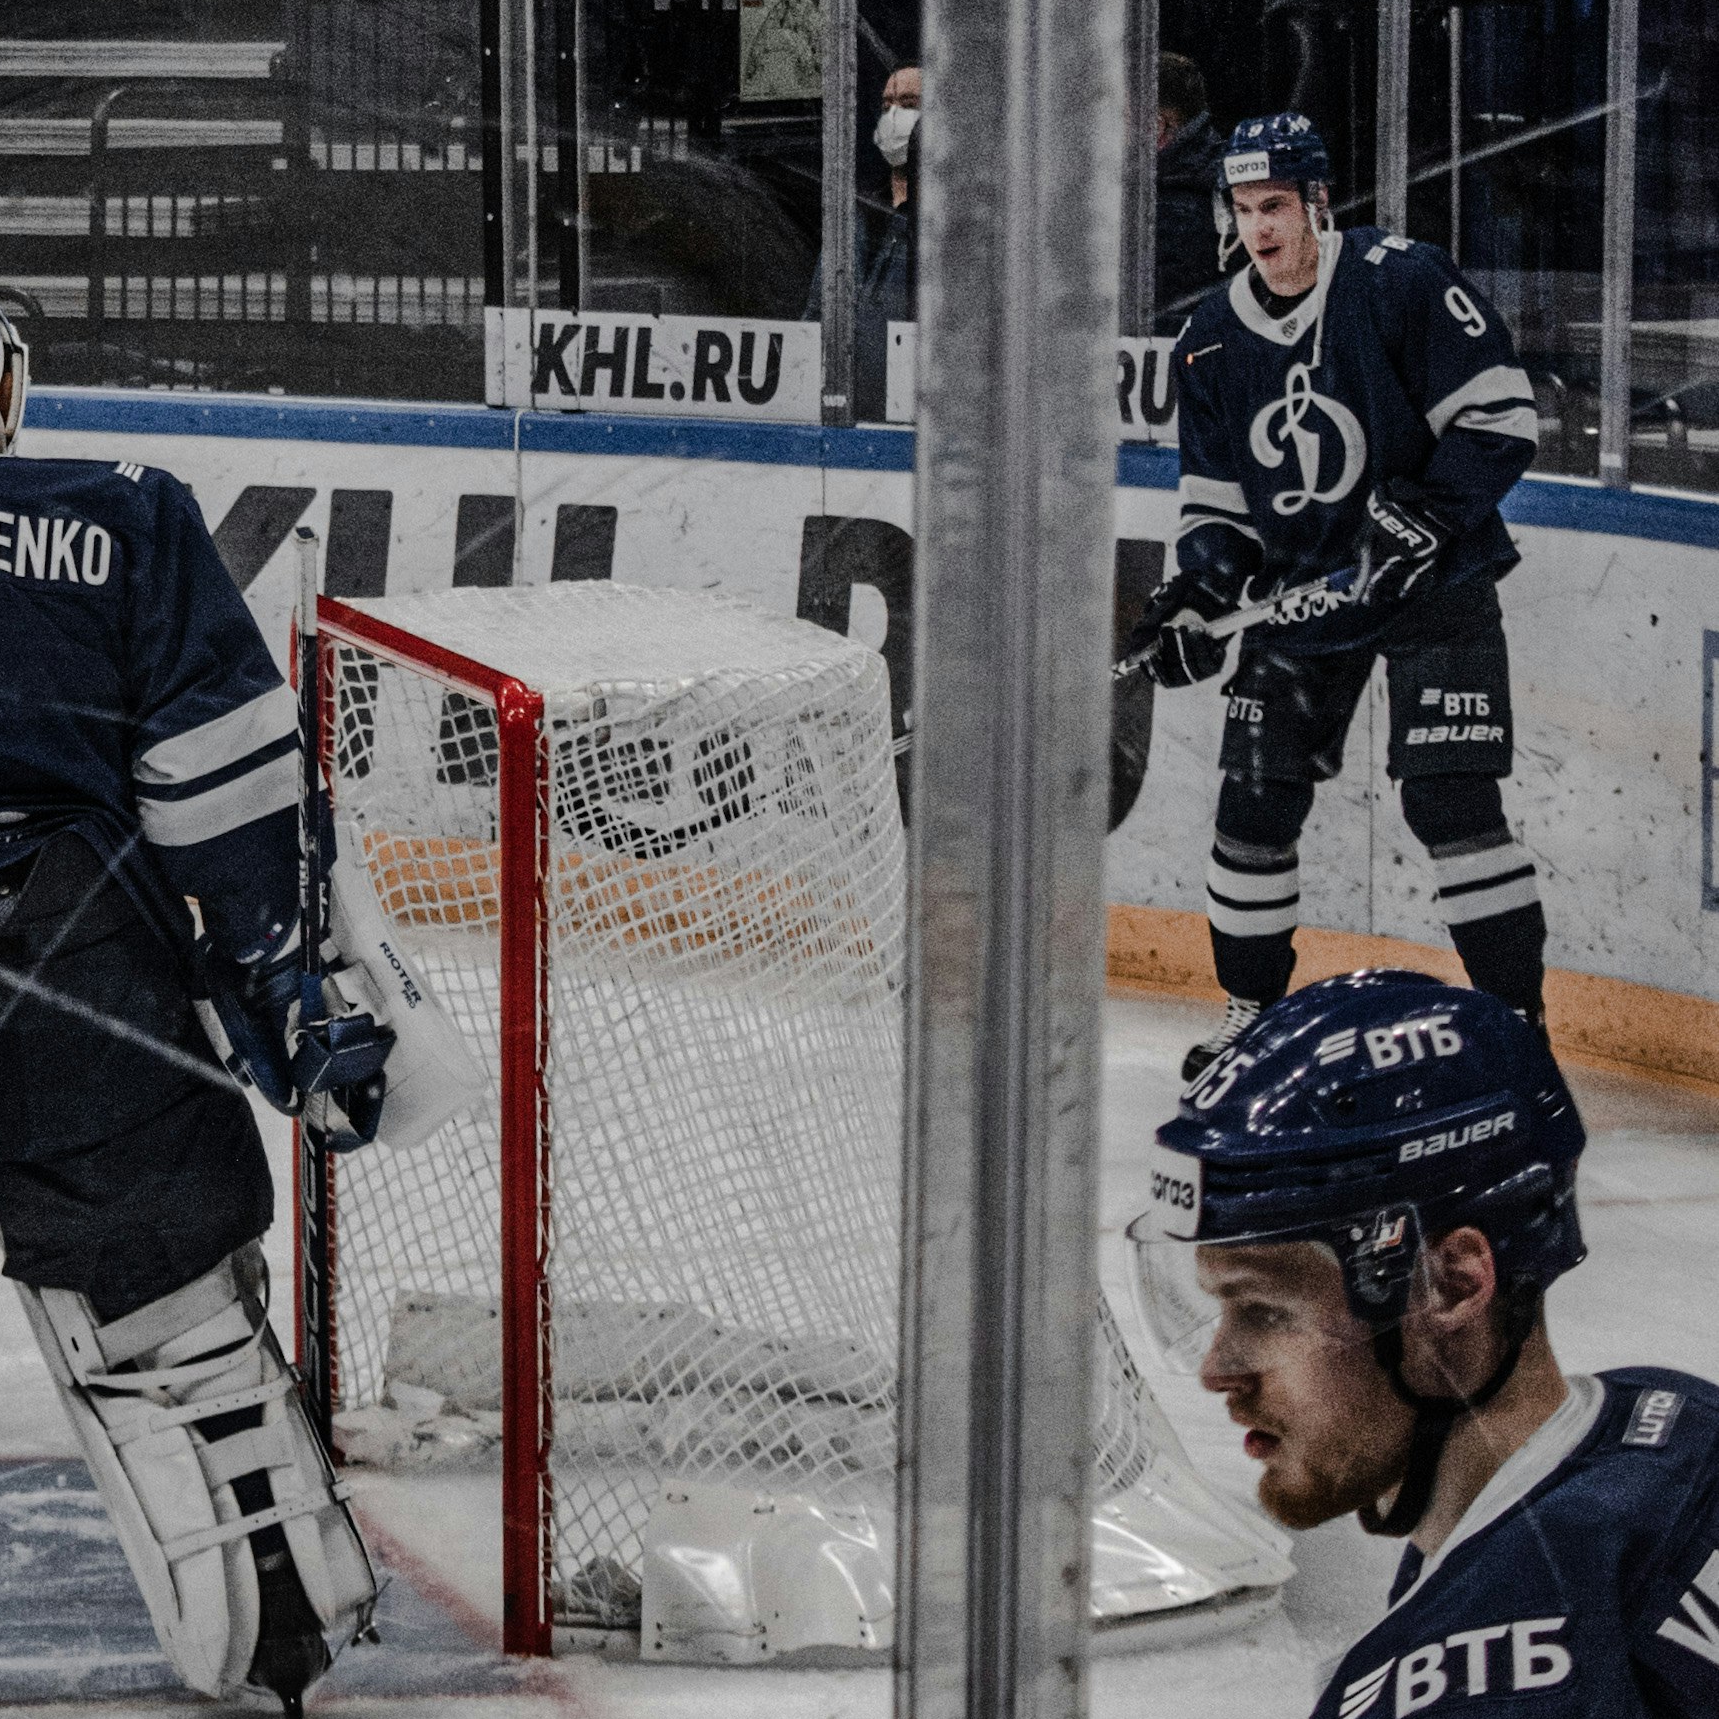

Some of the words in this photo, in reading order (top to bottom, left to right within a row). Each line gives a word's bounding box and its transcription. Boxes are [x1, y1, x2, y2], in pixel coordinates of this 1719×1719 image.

[1444, 285, 1487, 338] 9
[532, 324, 784, 406] KHL.RU
[1363, 1014, 1463, 1070] ВТБ
